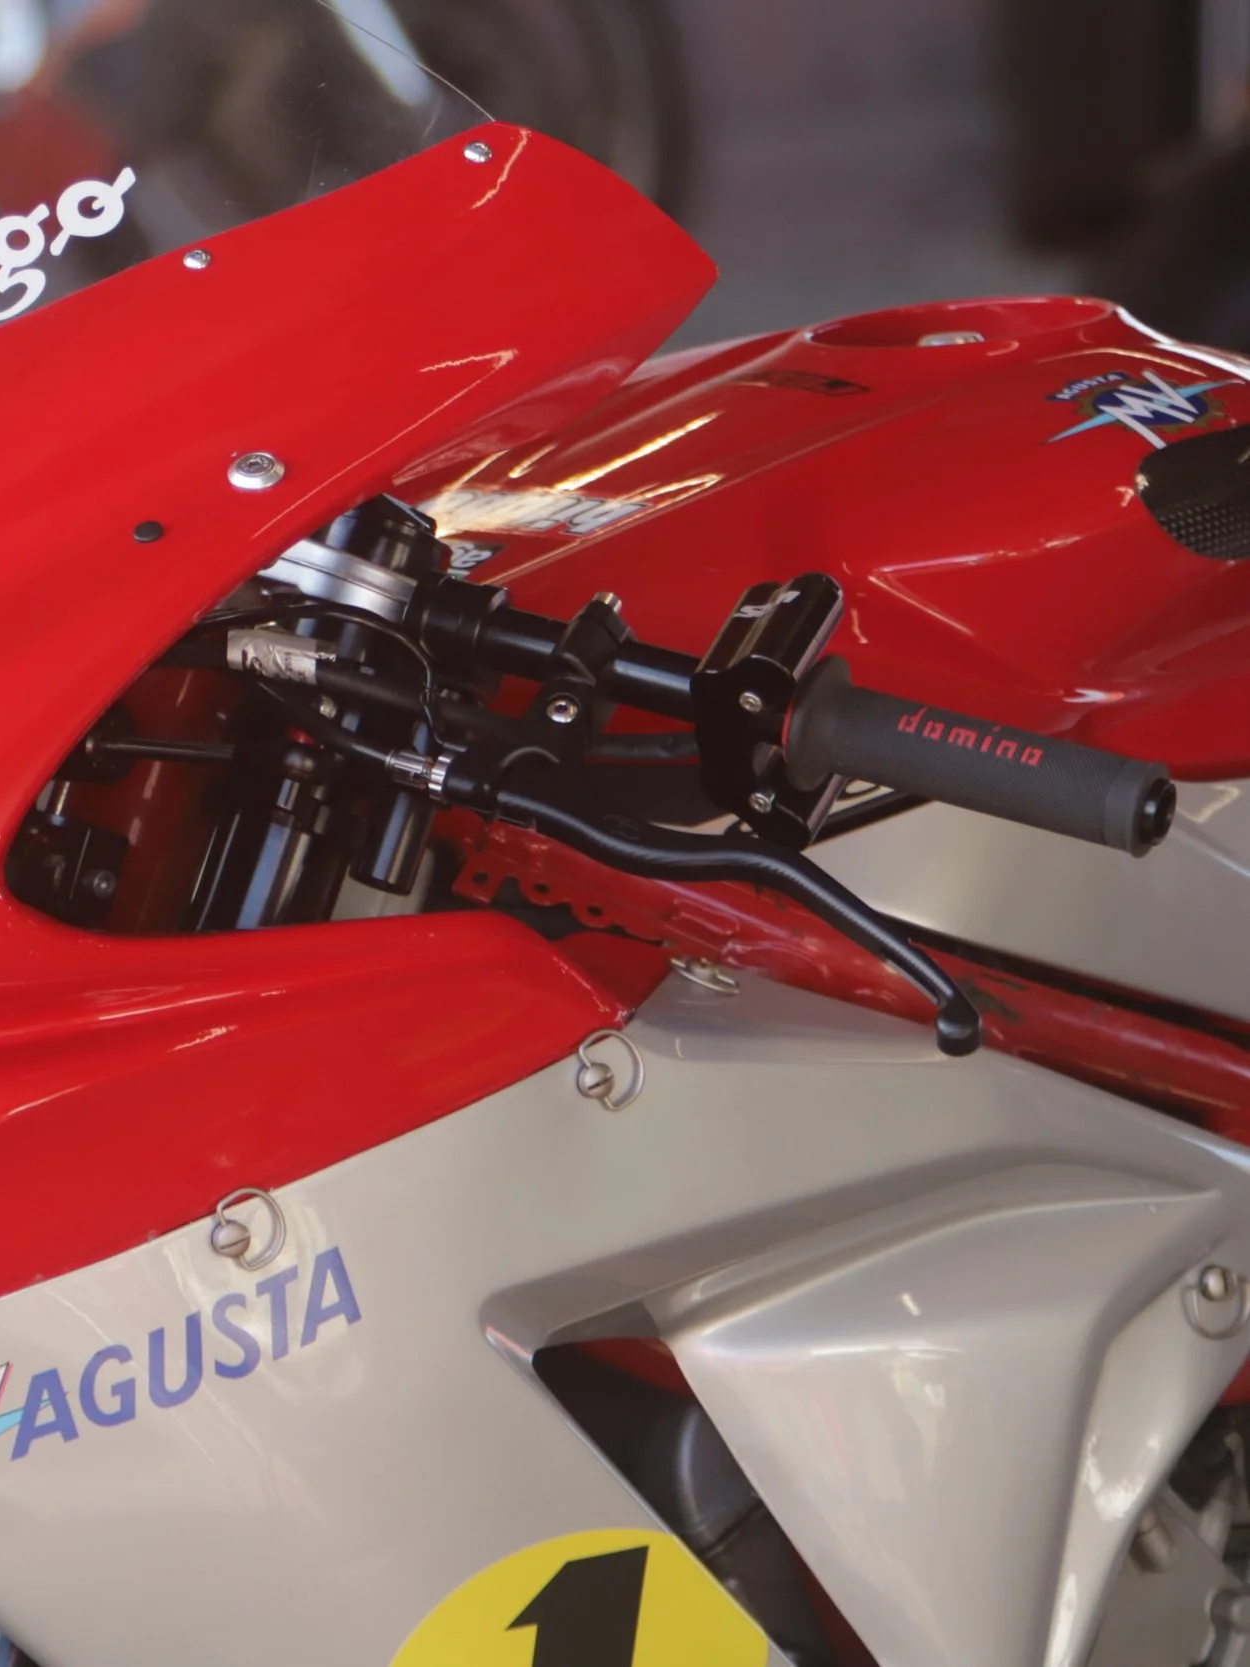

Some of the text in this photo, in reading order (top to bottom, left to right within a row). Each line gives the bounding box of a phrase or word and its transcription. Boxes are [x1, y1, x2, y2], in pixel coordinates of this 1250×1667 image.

[1097, 369, 1200, 450] MV
[897, 707, 1043, 767] domino
[11, 1246, 362, 1462] AGUSTA
